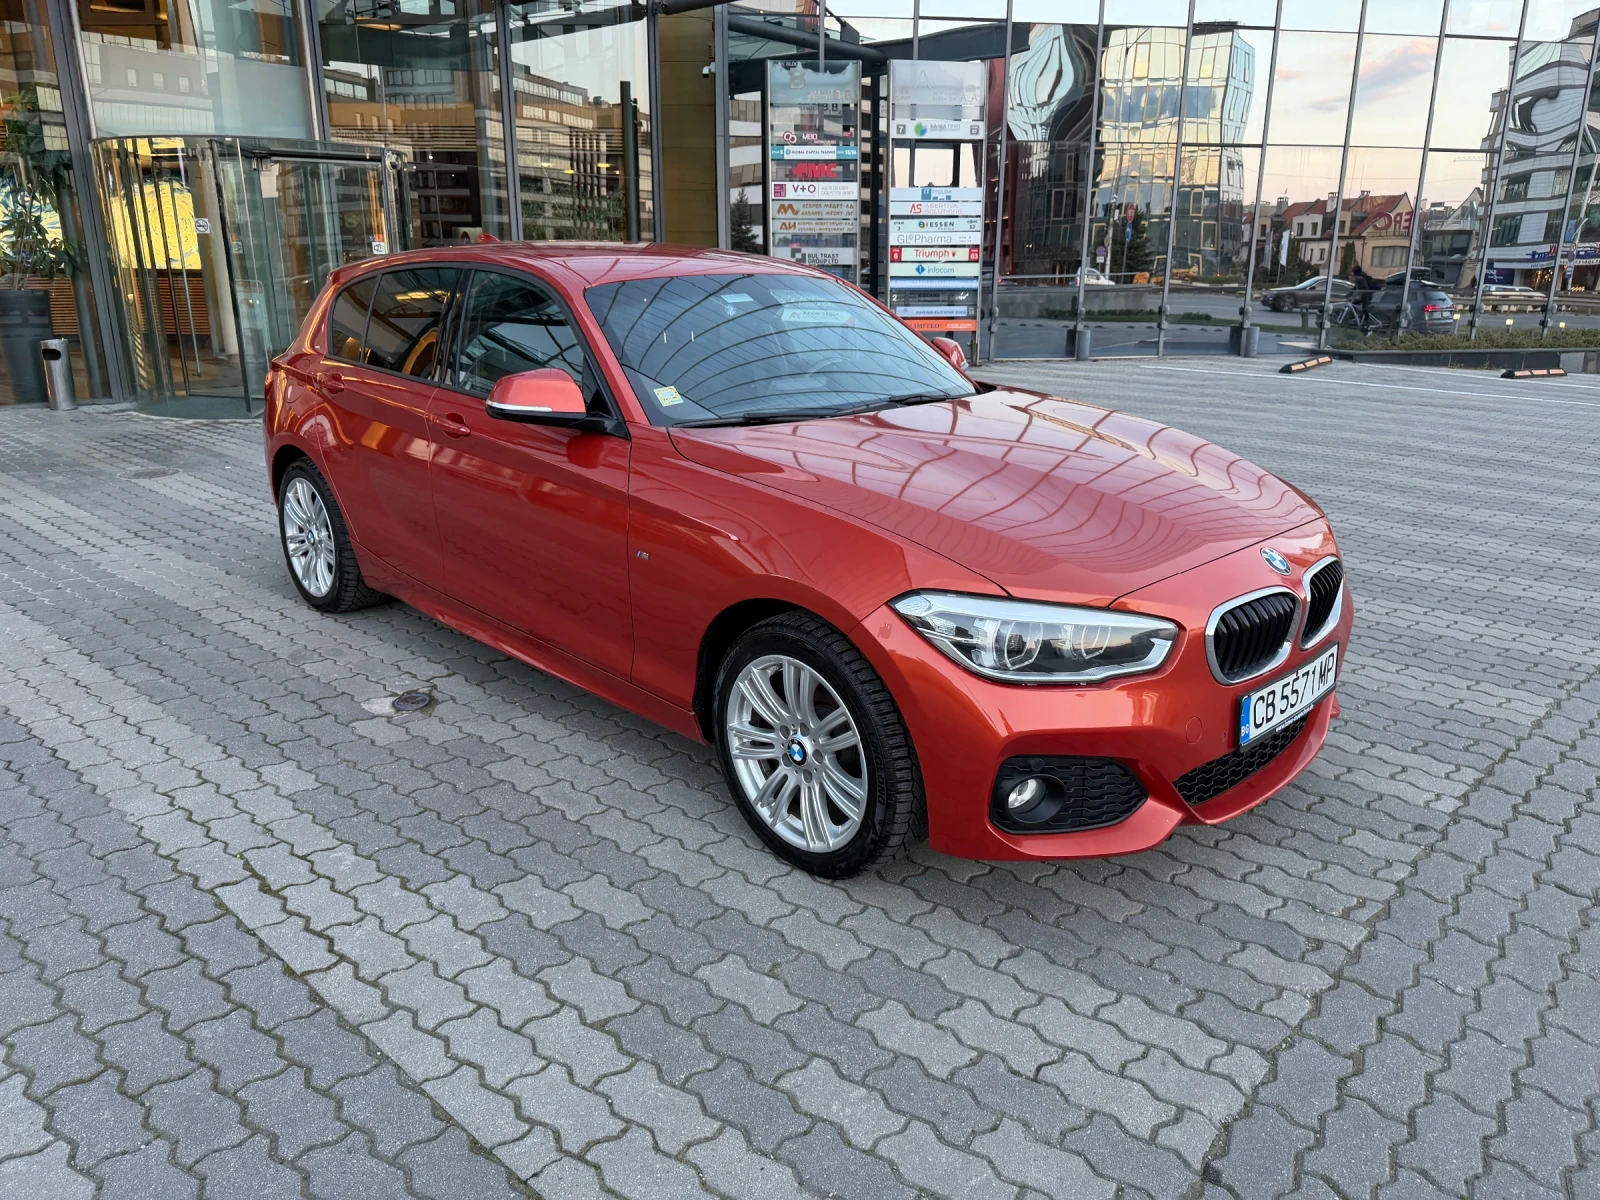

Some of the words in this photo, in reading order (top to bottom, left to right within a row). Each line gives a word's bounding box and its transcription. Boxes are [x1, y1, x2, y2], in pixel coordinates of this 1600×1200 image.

[914, 234, 952, 244] Pharma
[893, 252, 899, 260] 6
[914, 248, 950, 259] Triumph
[970, 252, 979, 260] 63
[927, 266, 955, 274] infocom
[892, 294, 898, 302] 2
[1253, 689, 1276, 729] CB
[1280, 665, 1317, 715] 5571
[1318, 652, 1335, 691] MP
